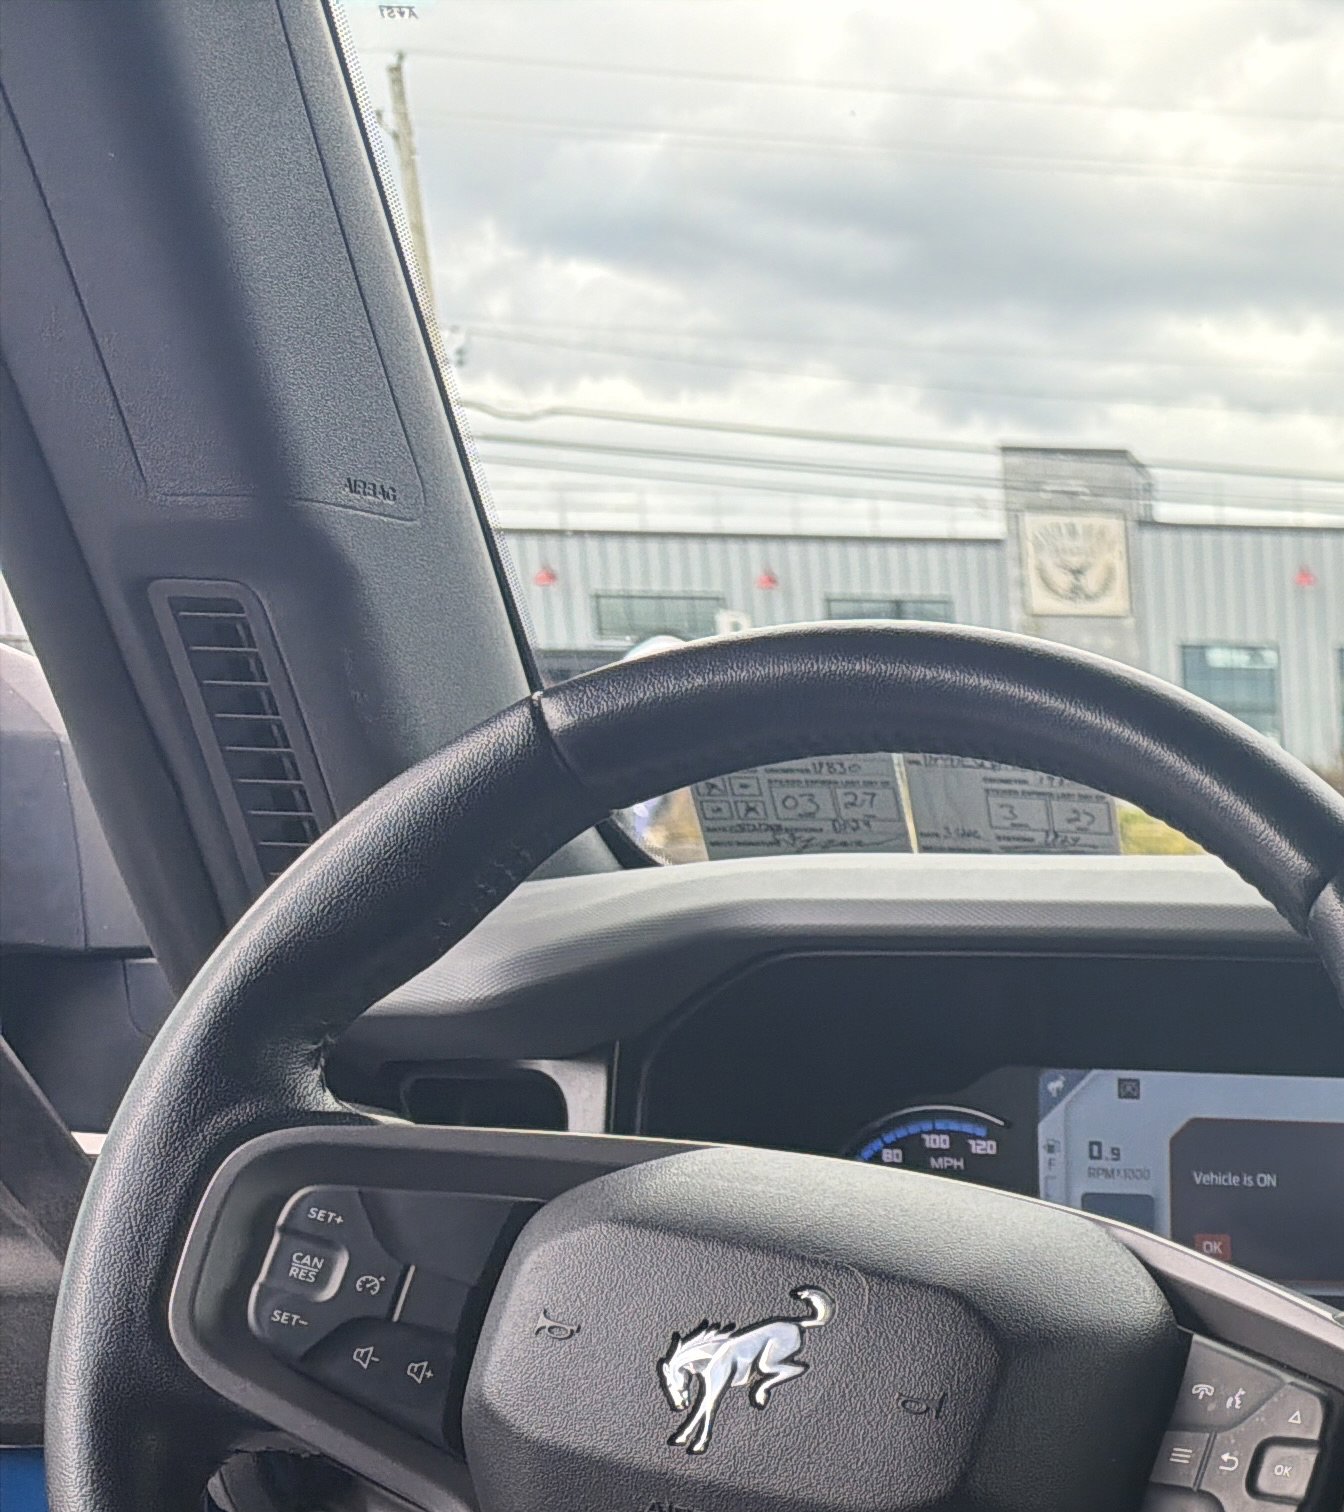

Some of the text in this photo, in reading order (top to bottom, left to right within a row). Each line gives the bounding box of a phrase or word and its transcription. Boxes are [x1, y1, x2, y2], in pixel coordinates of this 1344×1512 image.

[921, 1134, 950, 1150] 100
[968, 1139, 997, 1155] 120
[882, 1149, 903, 1163] 80
[1088, 1140, 1121, 1162] 0.9
[930, 1157, 964, 1170] MPH
[1194, 1171, 1277, 1188] Vehicle is ON
[307, 1207, 344, 1225] SET+
[1203, 1241, 1223, 1255] OK
[292, 1252, 324, 1270] CAN
[288, 1267, 317, 1284] RES
[1274, 1465, 1293, 1477] OK
